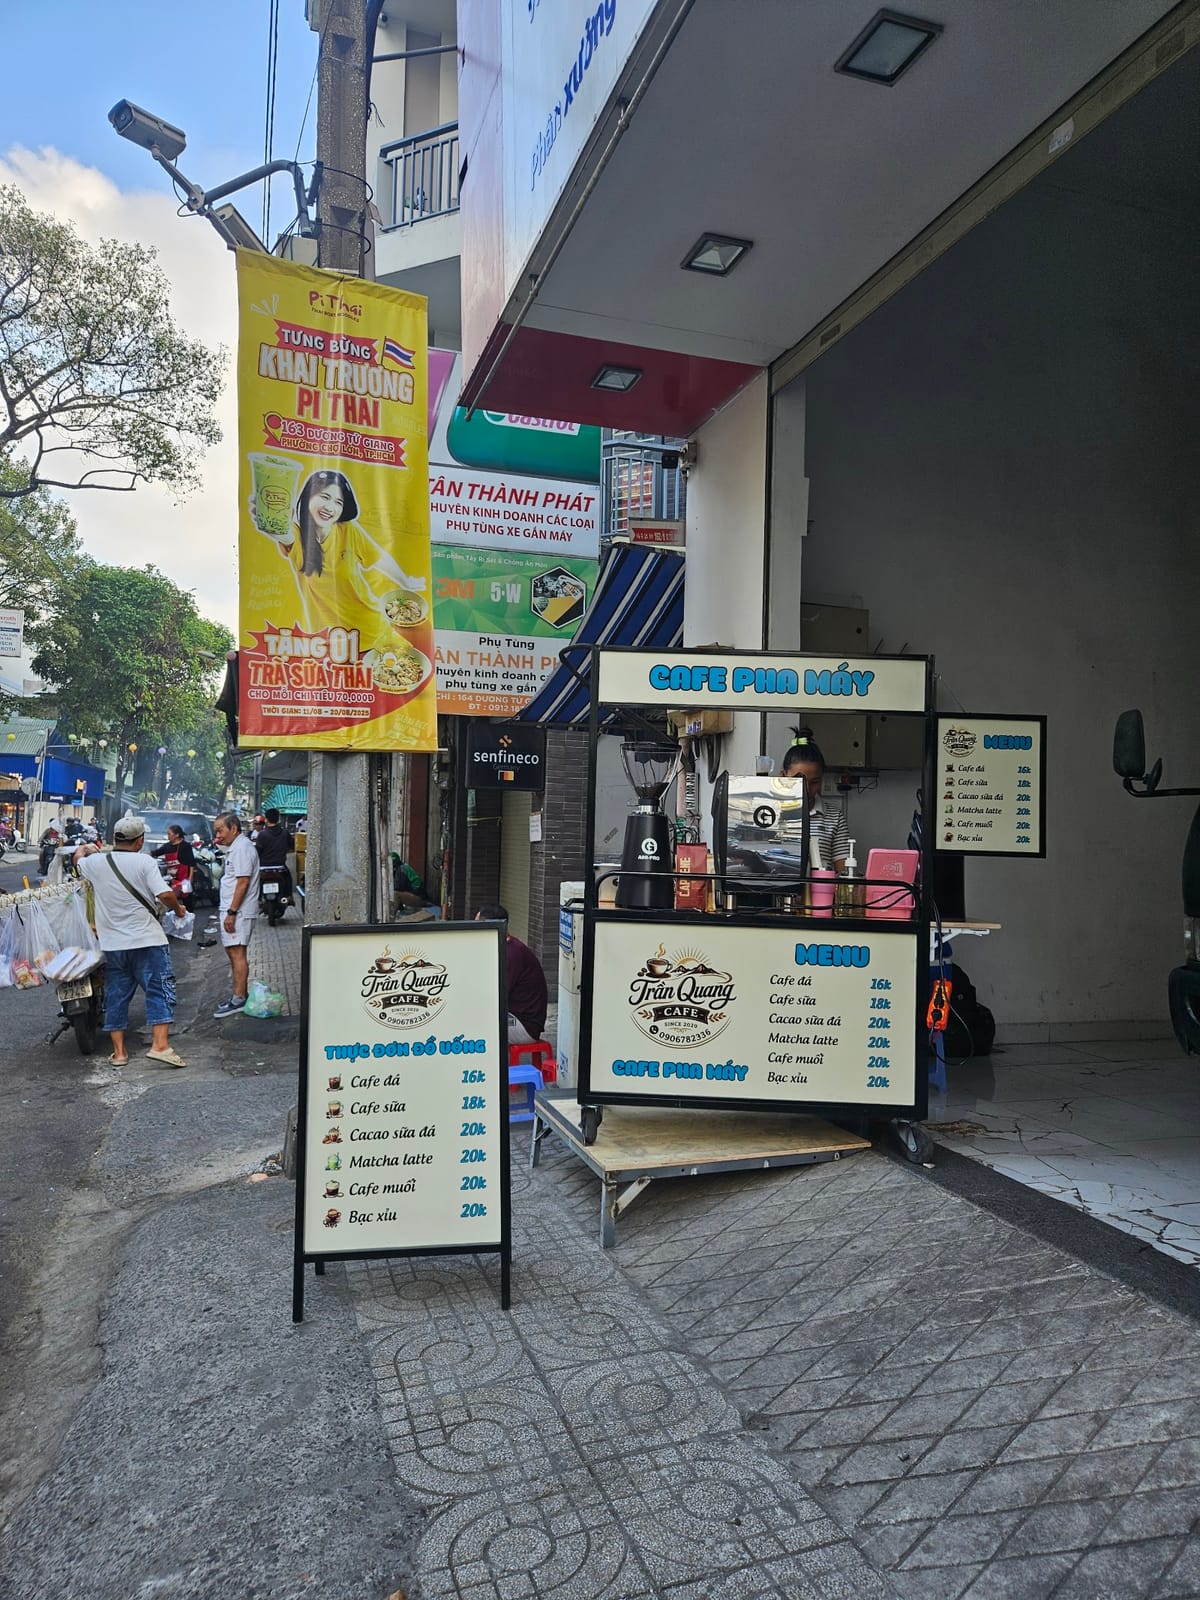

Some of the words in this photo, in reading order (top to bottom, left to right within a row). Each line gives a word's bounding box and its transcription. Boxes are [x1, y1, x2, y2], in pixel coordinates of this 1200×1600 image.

[281, 329, 324, 350] TƯNG
[330, 337, 370, 359] BỪNG
[258, 343, 318, 387] KHAI
[322, 357, 414, 405] TRƯƠNG
[297, 387, 320, 420] PI
[326, 393, 380, 429] THAI
[281, 421, 305, 437] 163
[363, 438, 394, 452] GIANG
[364, 449, 396, 462] TP.HCM
[468, 483, 539, 506] THÀNH
[542, 492, 595, 512] PHÁT
[473, 507, 500, 519] KINH
[503, 511, 543, 524] DOANH
[546, 514, 567, 527] CÁC
[570, 518, 594, 531] LOẠI
[446, 520, 470, 534] PHỤ
[473, 521, 504, 535] TÙNG
[507, 527, 520, 537] XE
[523, 526, 547, 540] GẮN
[550, 530, 573, 542] MÁY
[436, 577, 475, 600] 3M
[264, 627, 327, 663] TẶNG
[328, 627, 360, 664] 01
[479, 637, 501, 649] Phụ
[505, 638, 535, 650] Tùng
[467, 650, 534, 669] THÀNH
[249, 657, 288, 687] TRÀ
[291, 659, 328, 690] SỮA
[331, 661, 374, 690] THÁI
[475, 669, 498, 679] kinh
[502, 671, 536, 681] doanh
[649, 664, 727, 692] CAFE
[732, 667, 799, 695] PHA
[804, 662, 874, 697] MÁY
[248, 689, 270, 699] CHO
[272, 687, 291, 700] MỖI
[294, 691, 311, 701] CHI
[313, 689, 334, 701] TIÊU
[446, 680, 467, 690] phụ
[471, 681, 496, 692] tùng
[517, 682, 537, 693] gắn
[488, 704, 510, 712] 0912
[984, 735, 1032, 750] MENU
[474, 750, 539, 764] senfineco
[680, 857, 691, 897] CAPENE
[795, 943, 870, 968] MENU
[361, 975, 400, 997] Trần
[401, 970, 450, 996] Quang
[770, 975, 795, 987] Cafe
[797, 976, 812, 986] đá
[870, 978, 891, 990] 16k
[390, 995, 420, 1004] CAFE
[628, 979, 675, 1006] Trần
[677, 976, 737, 1010] Quang
[769, 994, 795, 1006] Cafe
[796, 996, 816, 1006] sữa
[869, 998, 891, 1009] 18k
[387, 1011, 430, 1025] 0906782336
[663, 1007, 699, 1018] CAFE
[768, 1013, 802, 1025] Cacao
[804, 1015, 824, 1026] sữa
[827, 1016, 842, 1026] đá
[868, 1017, 891, 1029] 20k
[659, 1029, 711, 1043] 0906782336
[768, 1033, 809, 1044] Matcha
[812, 1034, 839, 1045] latte
[867, 1037, 890, 1048] 20k
[324, 1042, 370, 1063] THỰC
[372, 1041, 410, 1058] ĐƠN
[439, 1034, 486, 1055] UỐNG
[768, 1052, 793, 1065] Cafe
[867, 1056, 890, 1068] 20k
[351, 1075, 380, 1089] Cafe
[383, 1073, 400, 1086] đá
[461, 1070, 486, 1083] 16k
[612, 1060, 659, 1077] CAFE
[663, 1062, 703, 1079] PHA
[706, 1059, 749, 1081] MÁY
[767, 1072, 788, 1085] Bạc
[790, 1072, 808, 1084] xỉu
[867, 1076, 889, 1088] 20k
[350, 1102, 380, 1116] Cafe
[383, 1100, 406, 1113] sữa
[461, 1096, 486, 1110] 18k
[350, 1128, 389, 1141] Cacao
[393, 1126, 415, 1139] sữa
[419, 1125, 436, 1137] đá
[460, 1122, 486, 1136] 20k
[349, 1155, 399, 1168] Matcha
[403, 1153, 433, 1165] latte
[460, 1149, 486, 1163] 20k
[349, 1182, 379, 1197] Cafe
[460, 1176, 487, 1190] 20k
[349, 1209, 373, 1225] Bạc
[376, 1208, 398, 1221] xỉu
[460, 1203, 487, 1218] 20k
